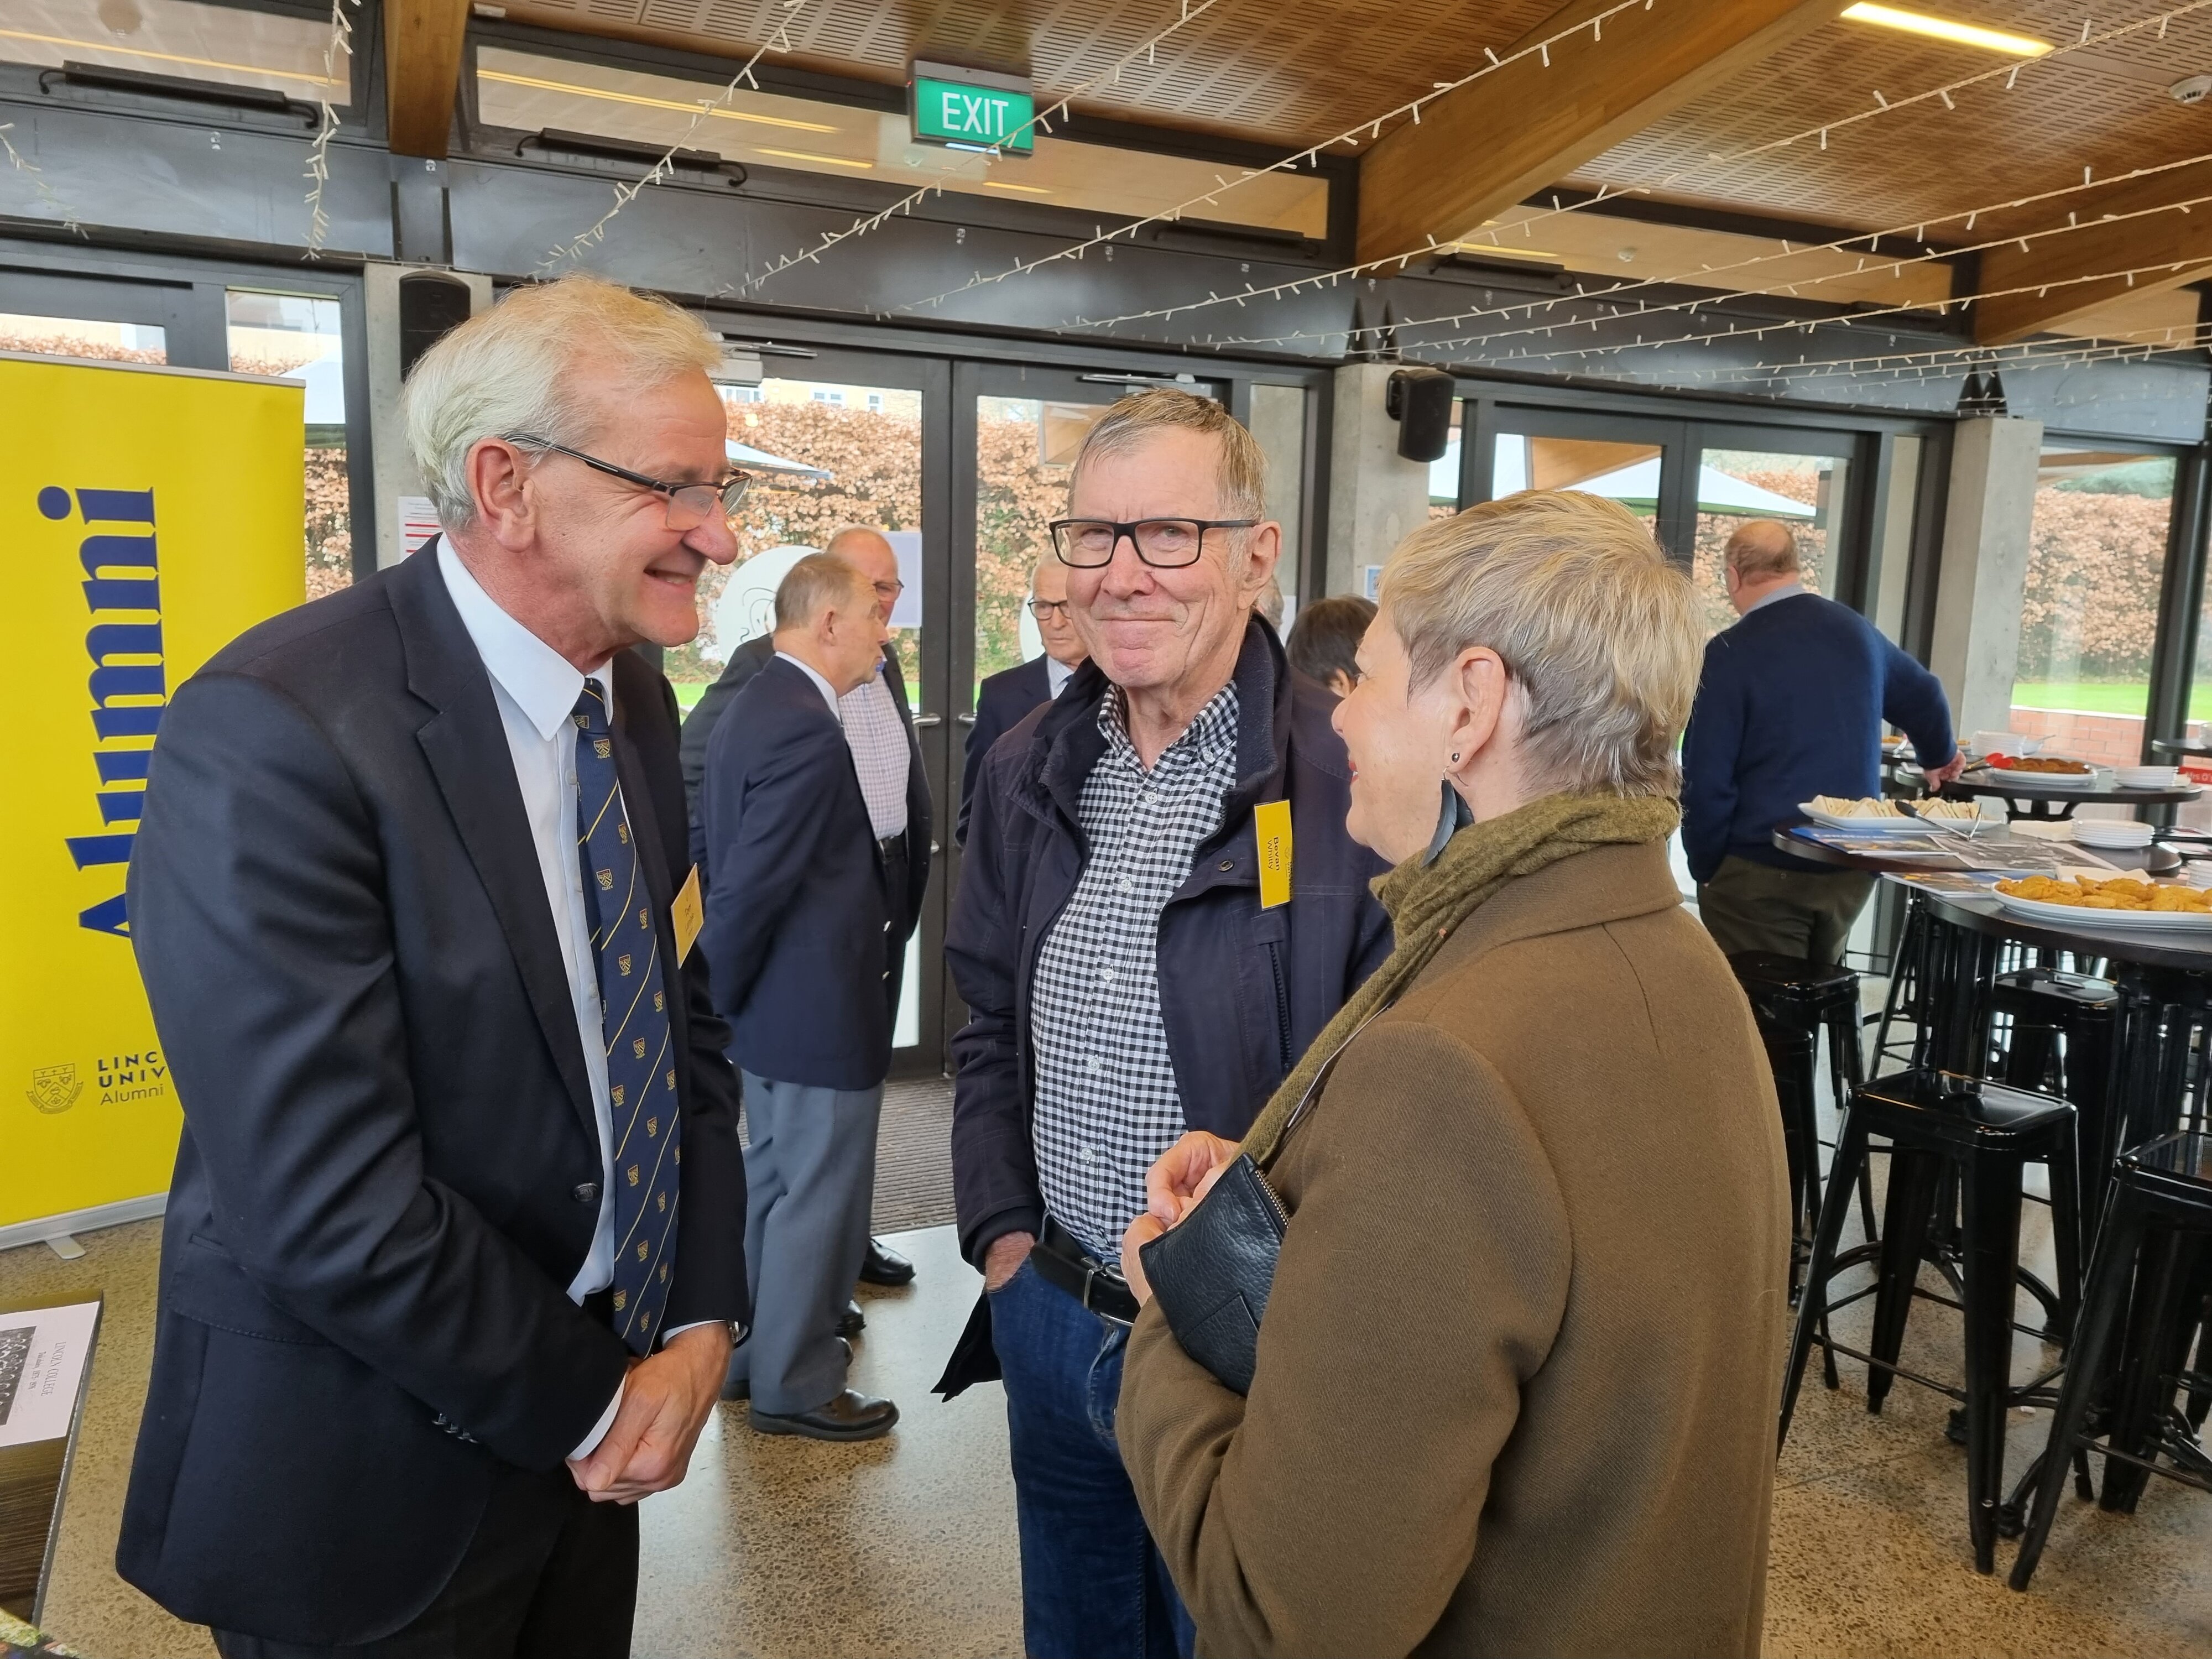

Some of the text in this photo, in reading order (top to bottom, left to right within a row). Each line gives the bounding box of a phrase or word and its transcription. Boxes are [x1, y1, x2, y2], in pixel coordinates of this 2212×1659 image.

[942, 92, 1009, 137] EXIT
[98, 1051, 158, 1072] LINC
[98, 1066, 165, 1088] UNIV
[100, 1084, 164, 1105] Alumni
[41, 1342, 66, 1396] LINCOLN COLLEGE
